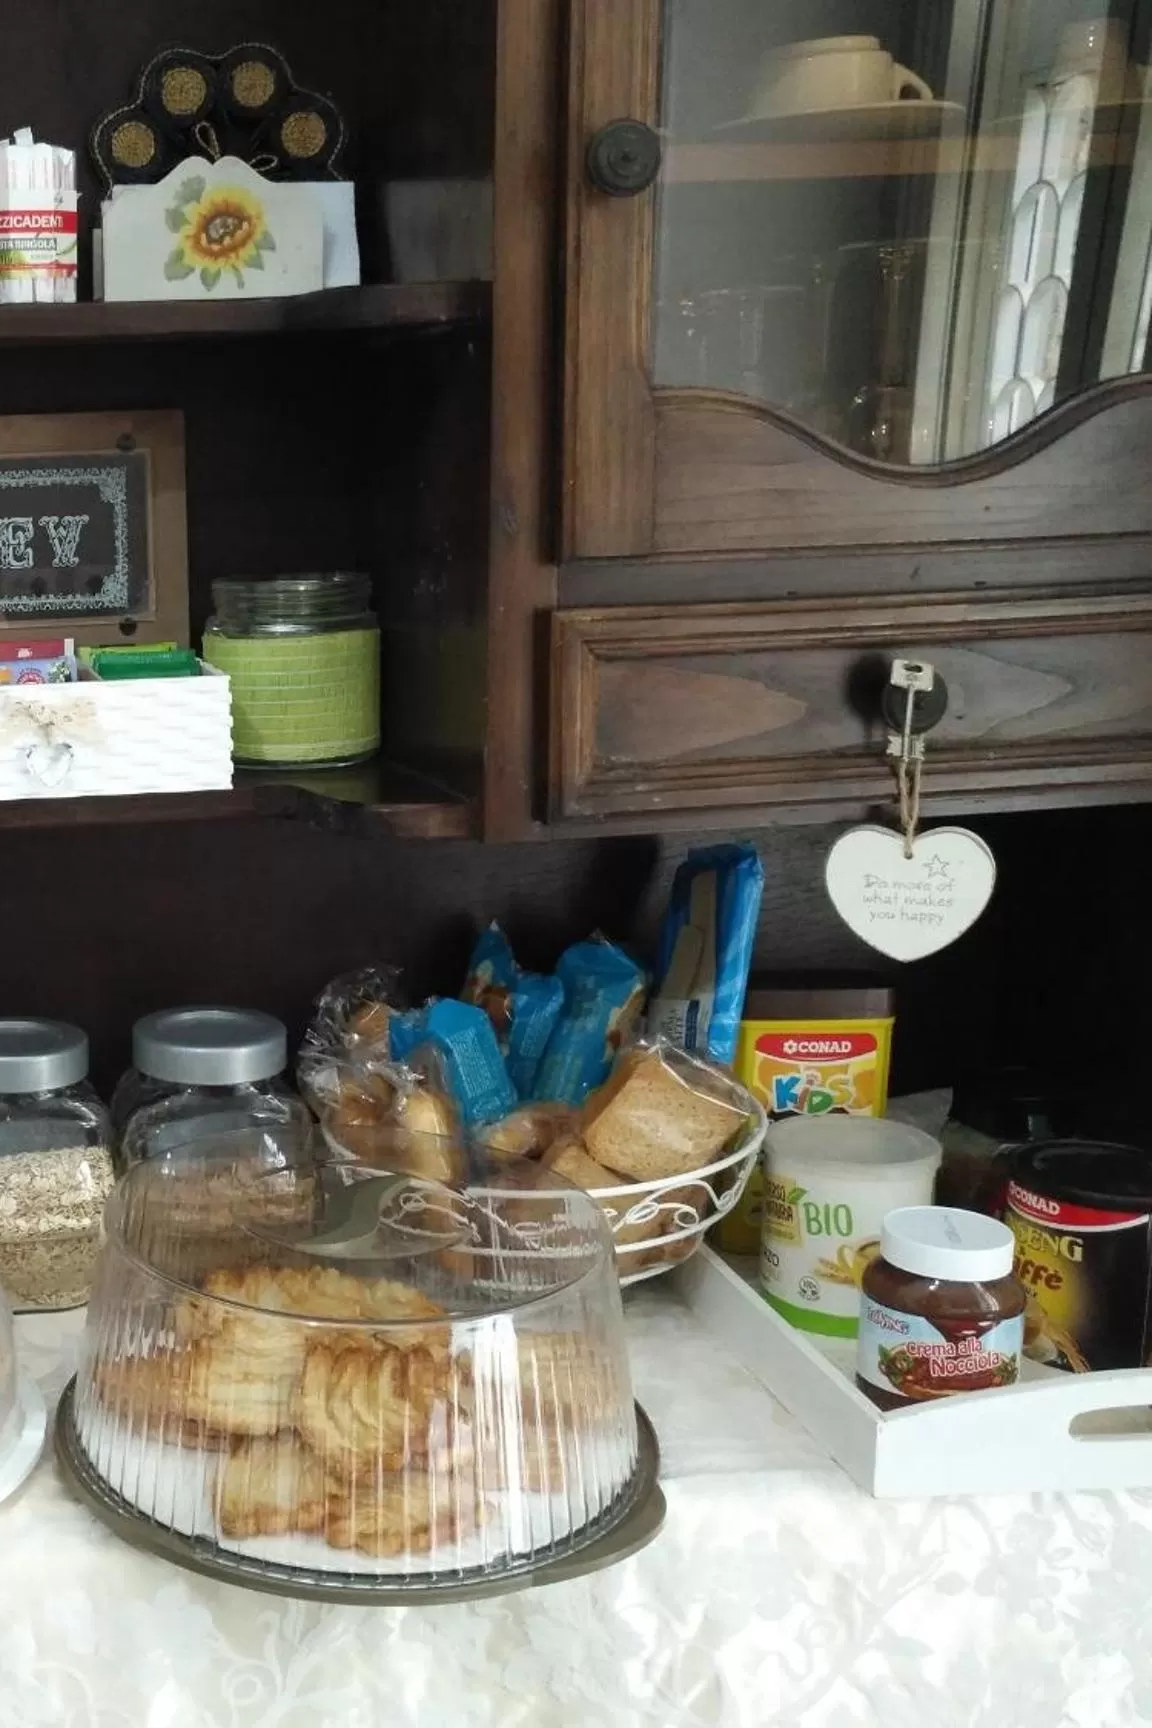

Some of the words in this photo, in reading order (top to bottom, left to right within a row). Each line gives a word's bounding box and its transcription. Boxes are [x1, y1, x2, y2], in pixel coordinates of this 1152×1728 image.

[862, 889, 898, 905] what
[903, 895, 953, 908] makes
[869, 910, 895, 922] you
[900, 907, 944, 926] happy
[798, 1040, 852, 1053] CONAD
[1015, 1187, 1060, 1215] CONAD
[803, 1202, 854, 1237] BIO
[905, 1342, 956, 1357] Crema
[958, 1337, 983, 1355] alla
[930, 1350, 1002, 1378] Nocciola
